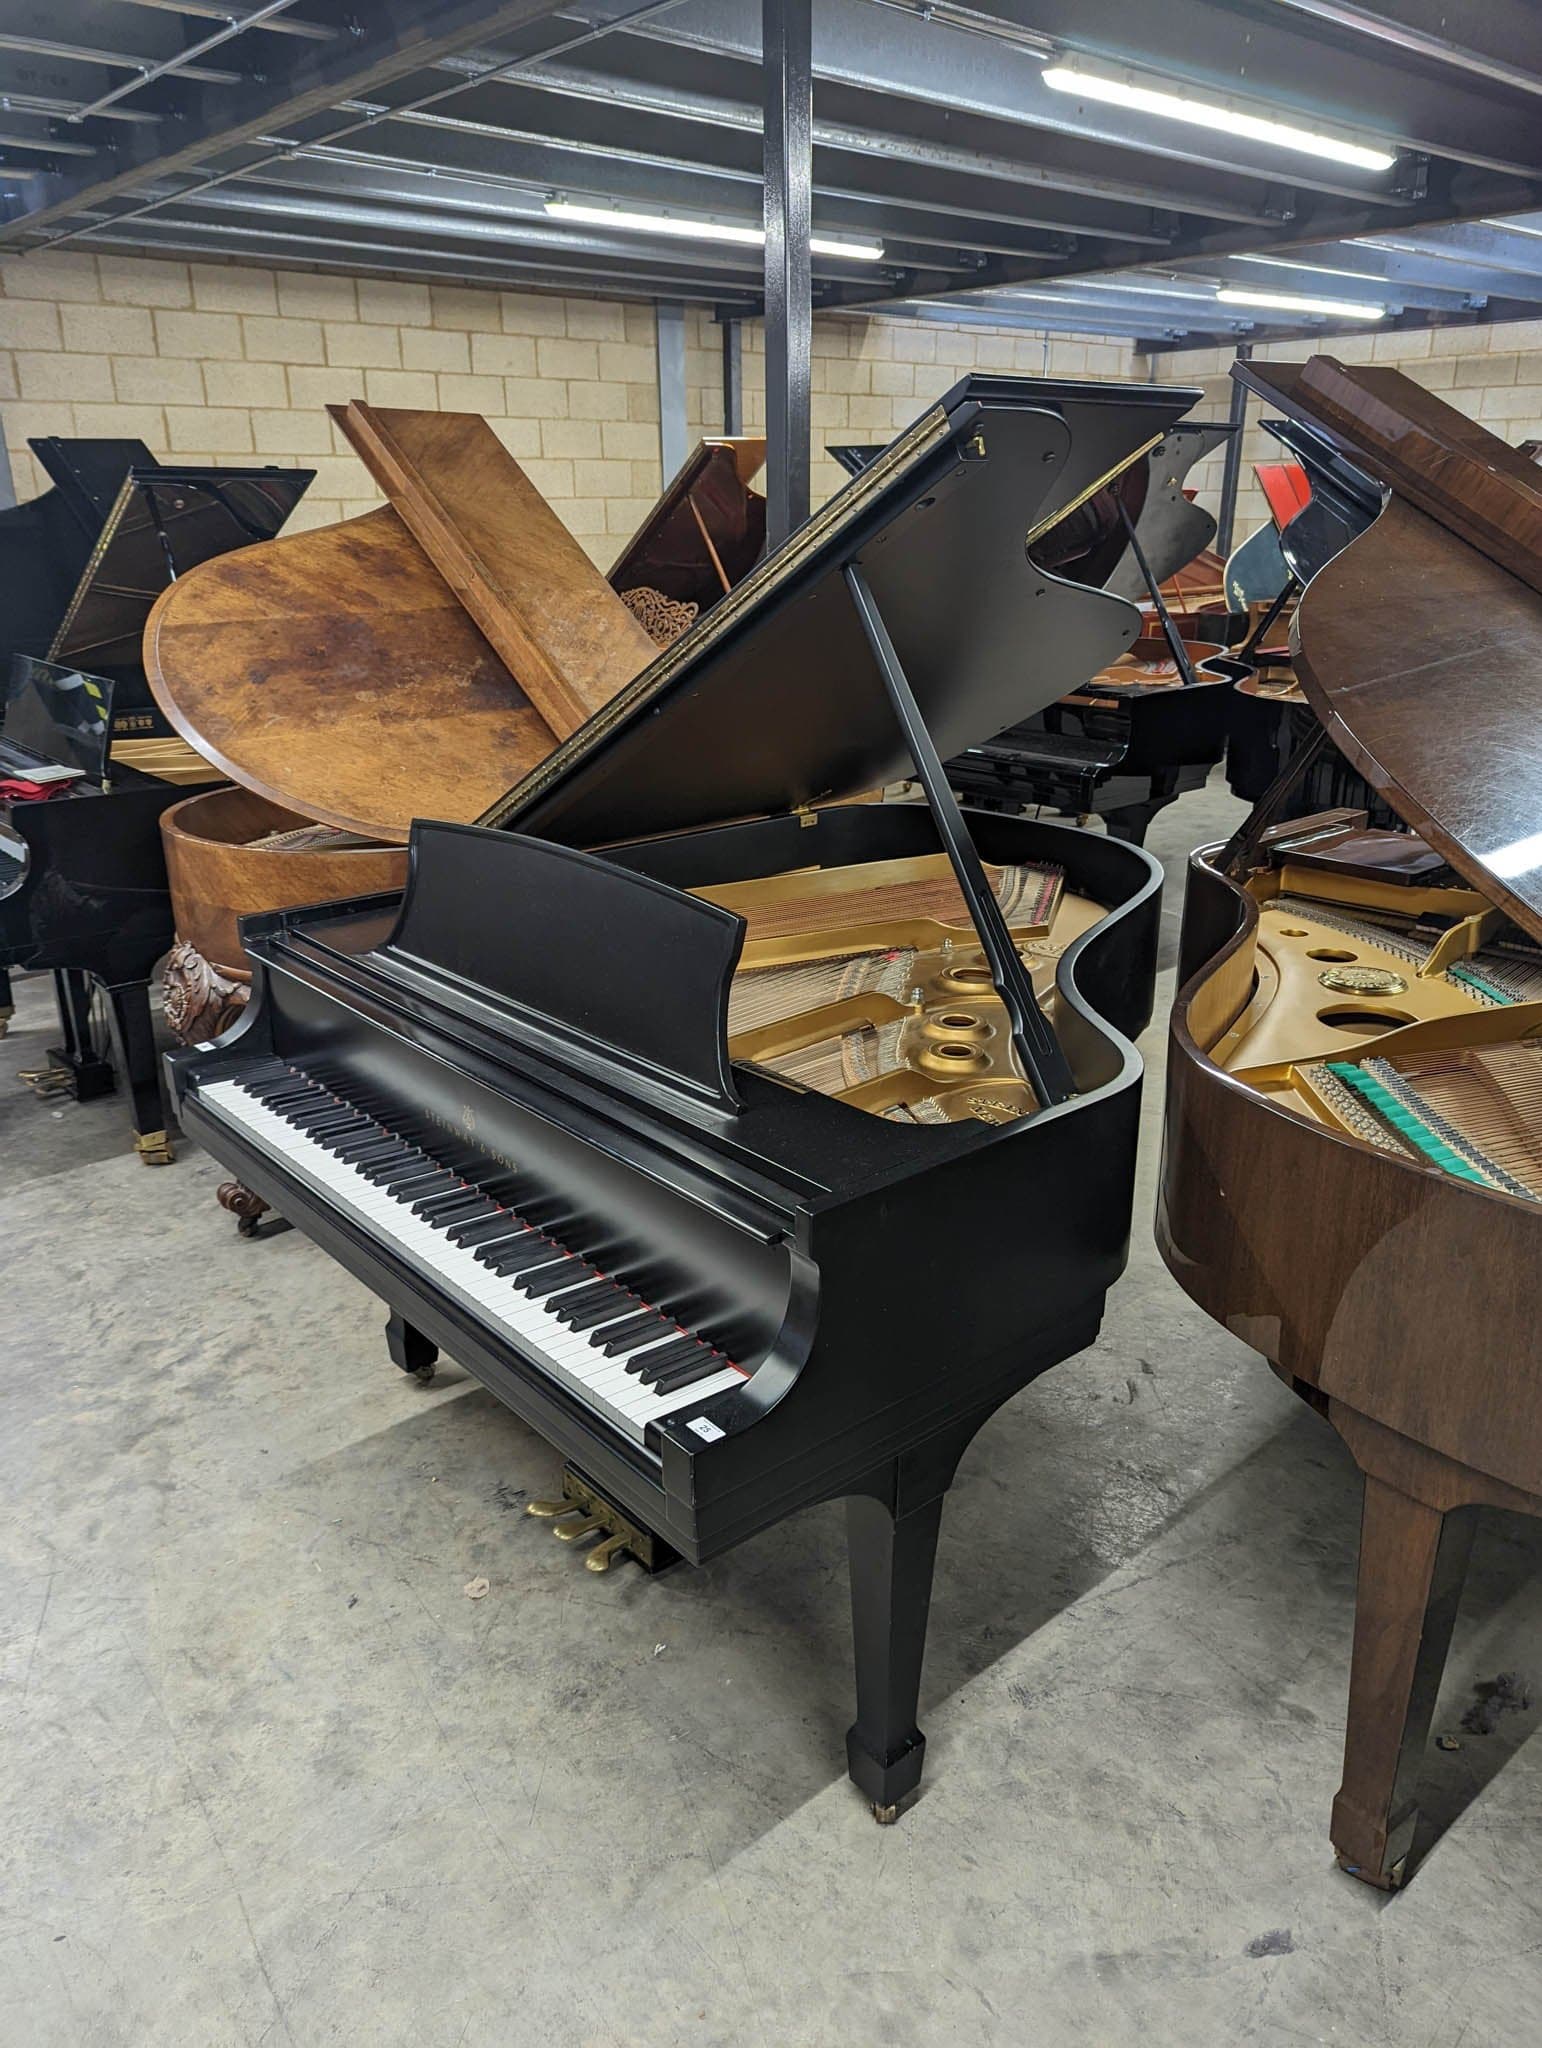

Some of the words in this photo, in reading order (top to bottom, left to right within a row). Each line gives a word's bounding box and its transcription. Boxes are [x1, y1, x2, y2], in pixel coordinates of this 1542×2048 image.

[425, 1108, 475, 1147] STEINWAY
[491, 1149, 518, 1174] SONS
[699, 1424, 711, 1433] 25
